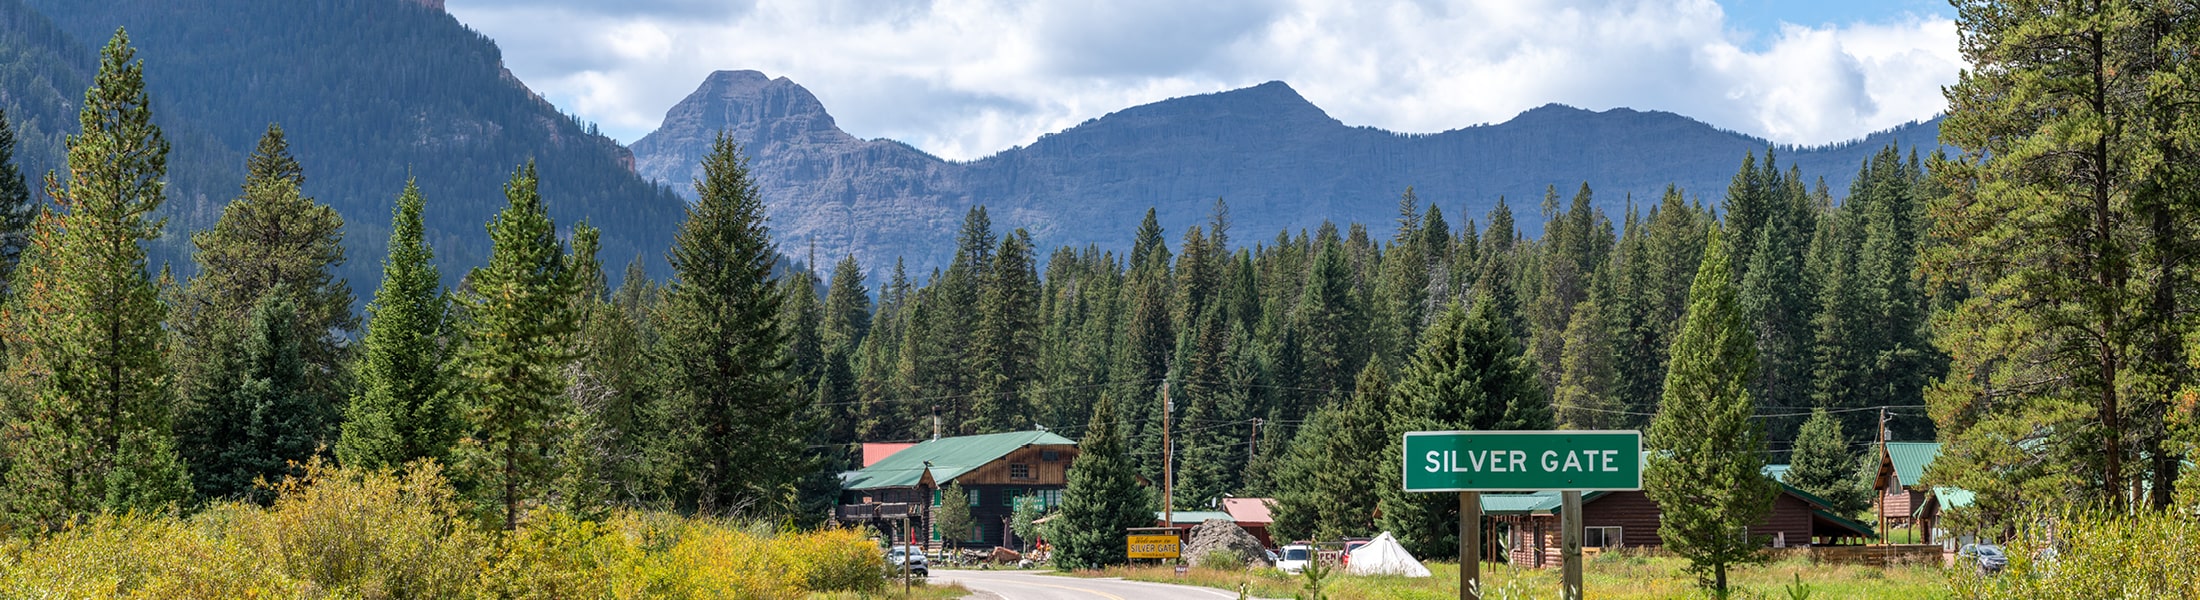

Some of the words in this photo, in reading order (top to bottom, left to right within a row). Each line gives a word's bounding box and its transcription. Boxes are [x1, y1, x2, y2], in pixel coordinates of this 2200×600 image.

[1424, 450, 1527, 473] SILVER
[1541, 449, 1619, 473] GATE
[1130, 544, 1155, 553] SILVER
[1157, 544, 1177, 553] GATE
